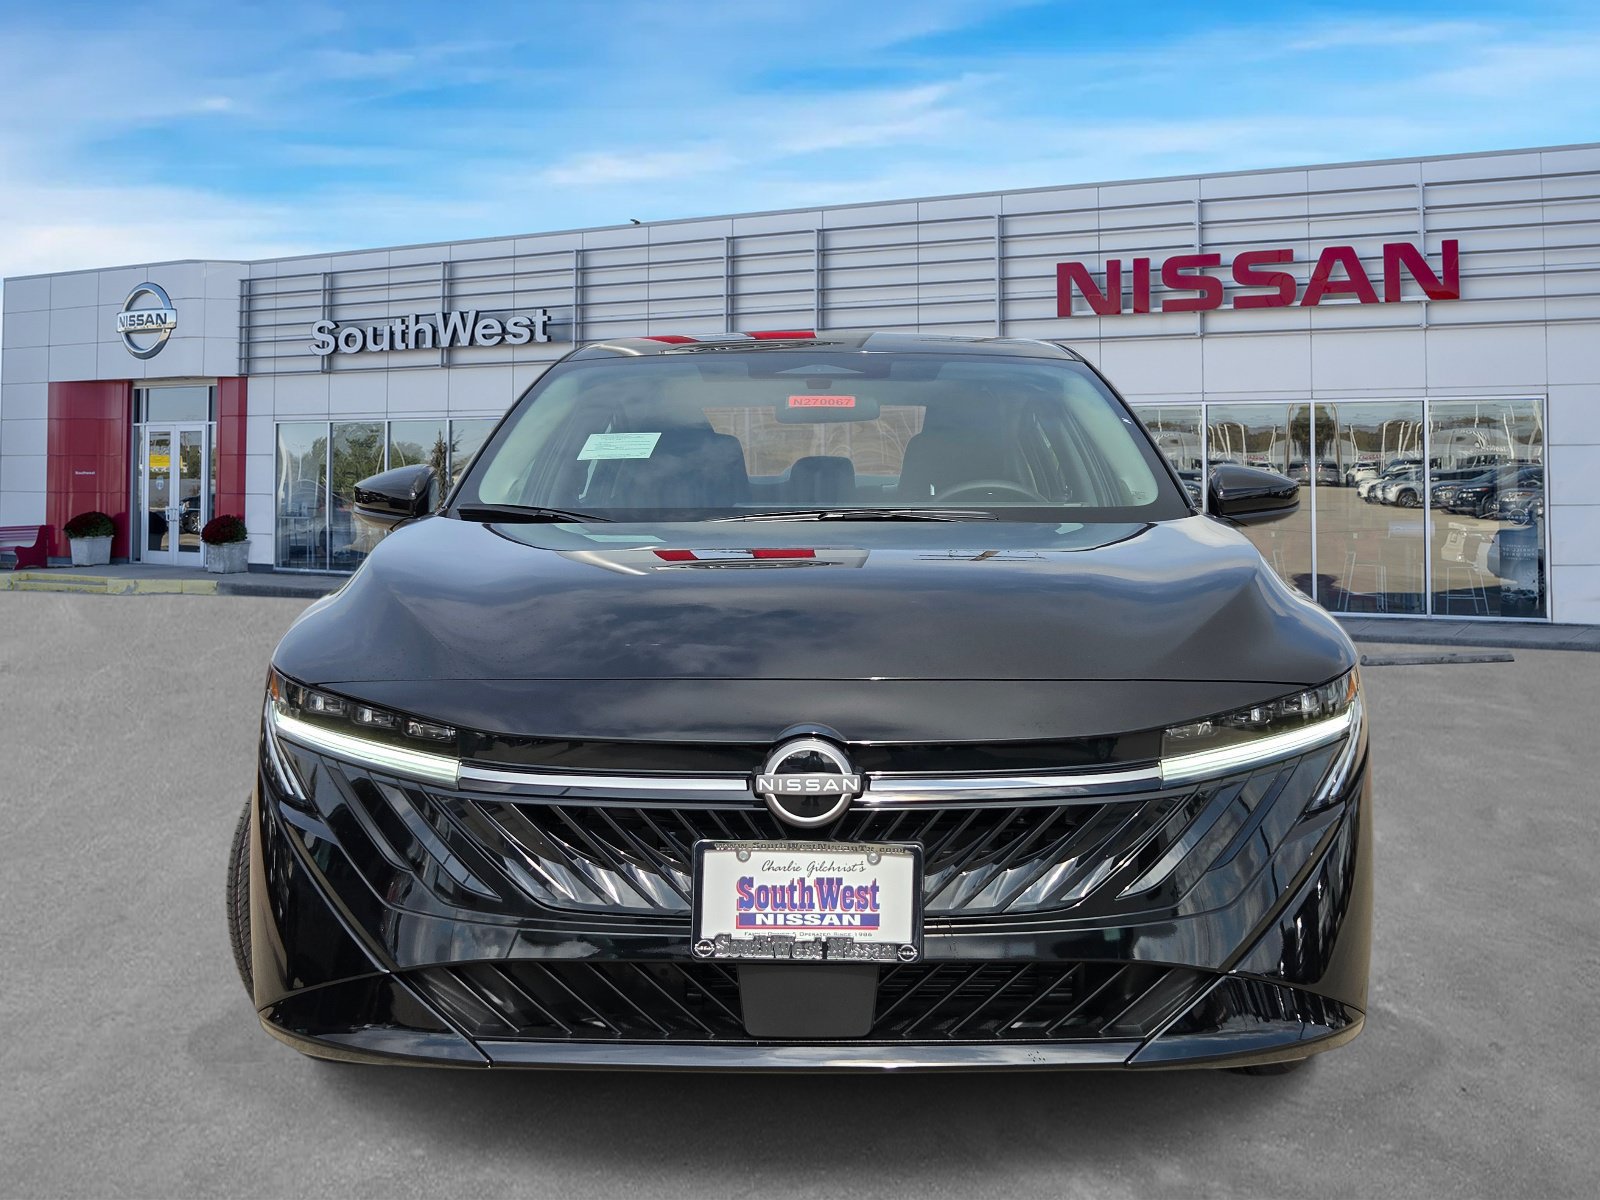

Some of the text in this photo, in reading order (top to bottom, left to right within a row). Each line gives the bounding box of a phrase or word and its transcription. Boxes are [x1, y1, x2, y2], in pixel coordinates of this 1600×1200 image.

[1056, 239, 1461, 318] NISSAN
[118, 312, 167, 329] NISSAN
[308, 308, 552, 356] SouthWest
[793, 398, 851, 406] N270067
[759, 778, 858, 792] NISSAN
[761, 860, 866, 878] Charlie Gilchrist's
[736, 876, 880, 912] SouthWest
[755, 913, 861, 926] NISSAN
